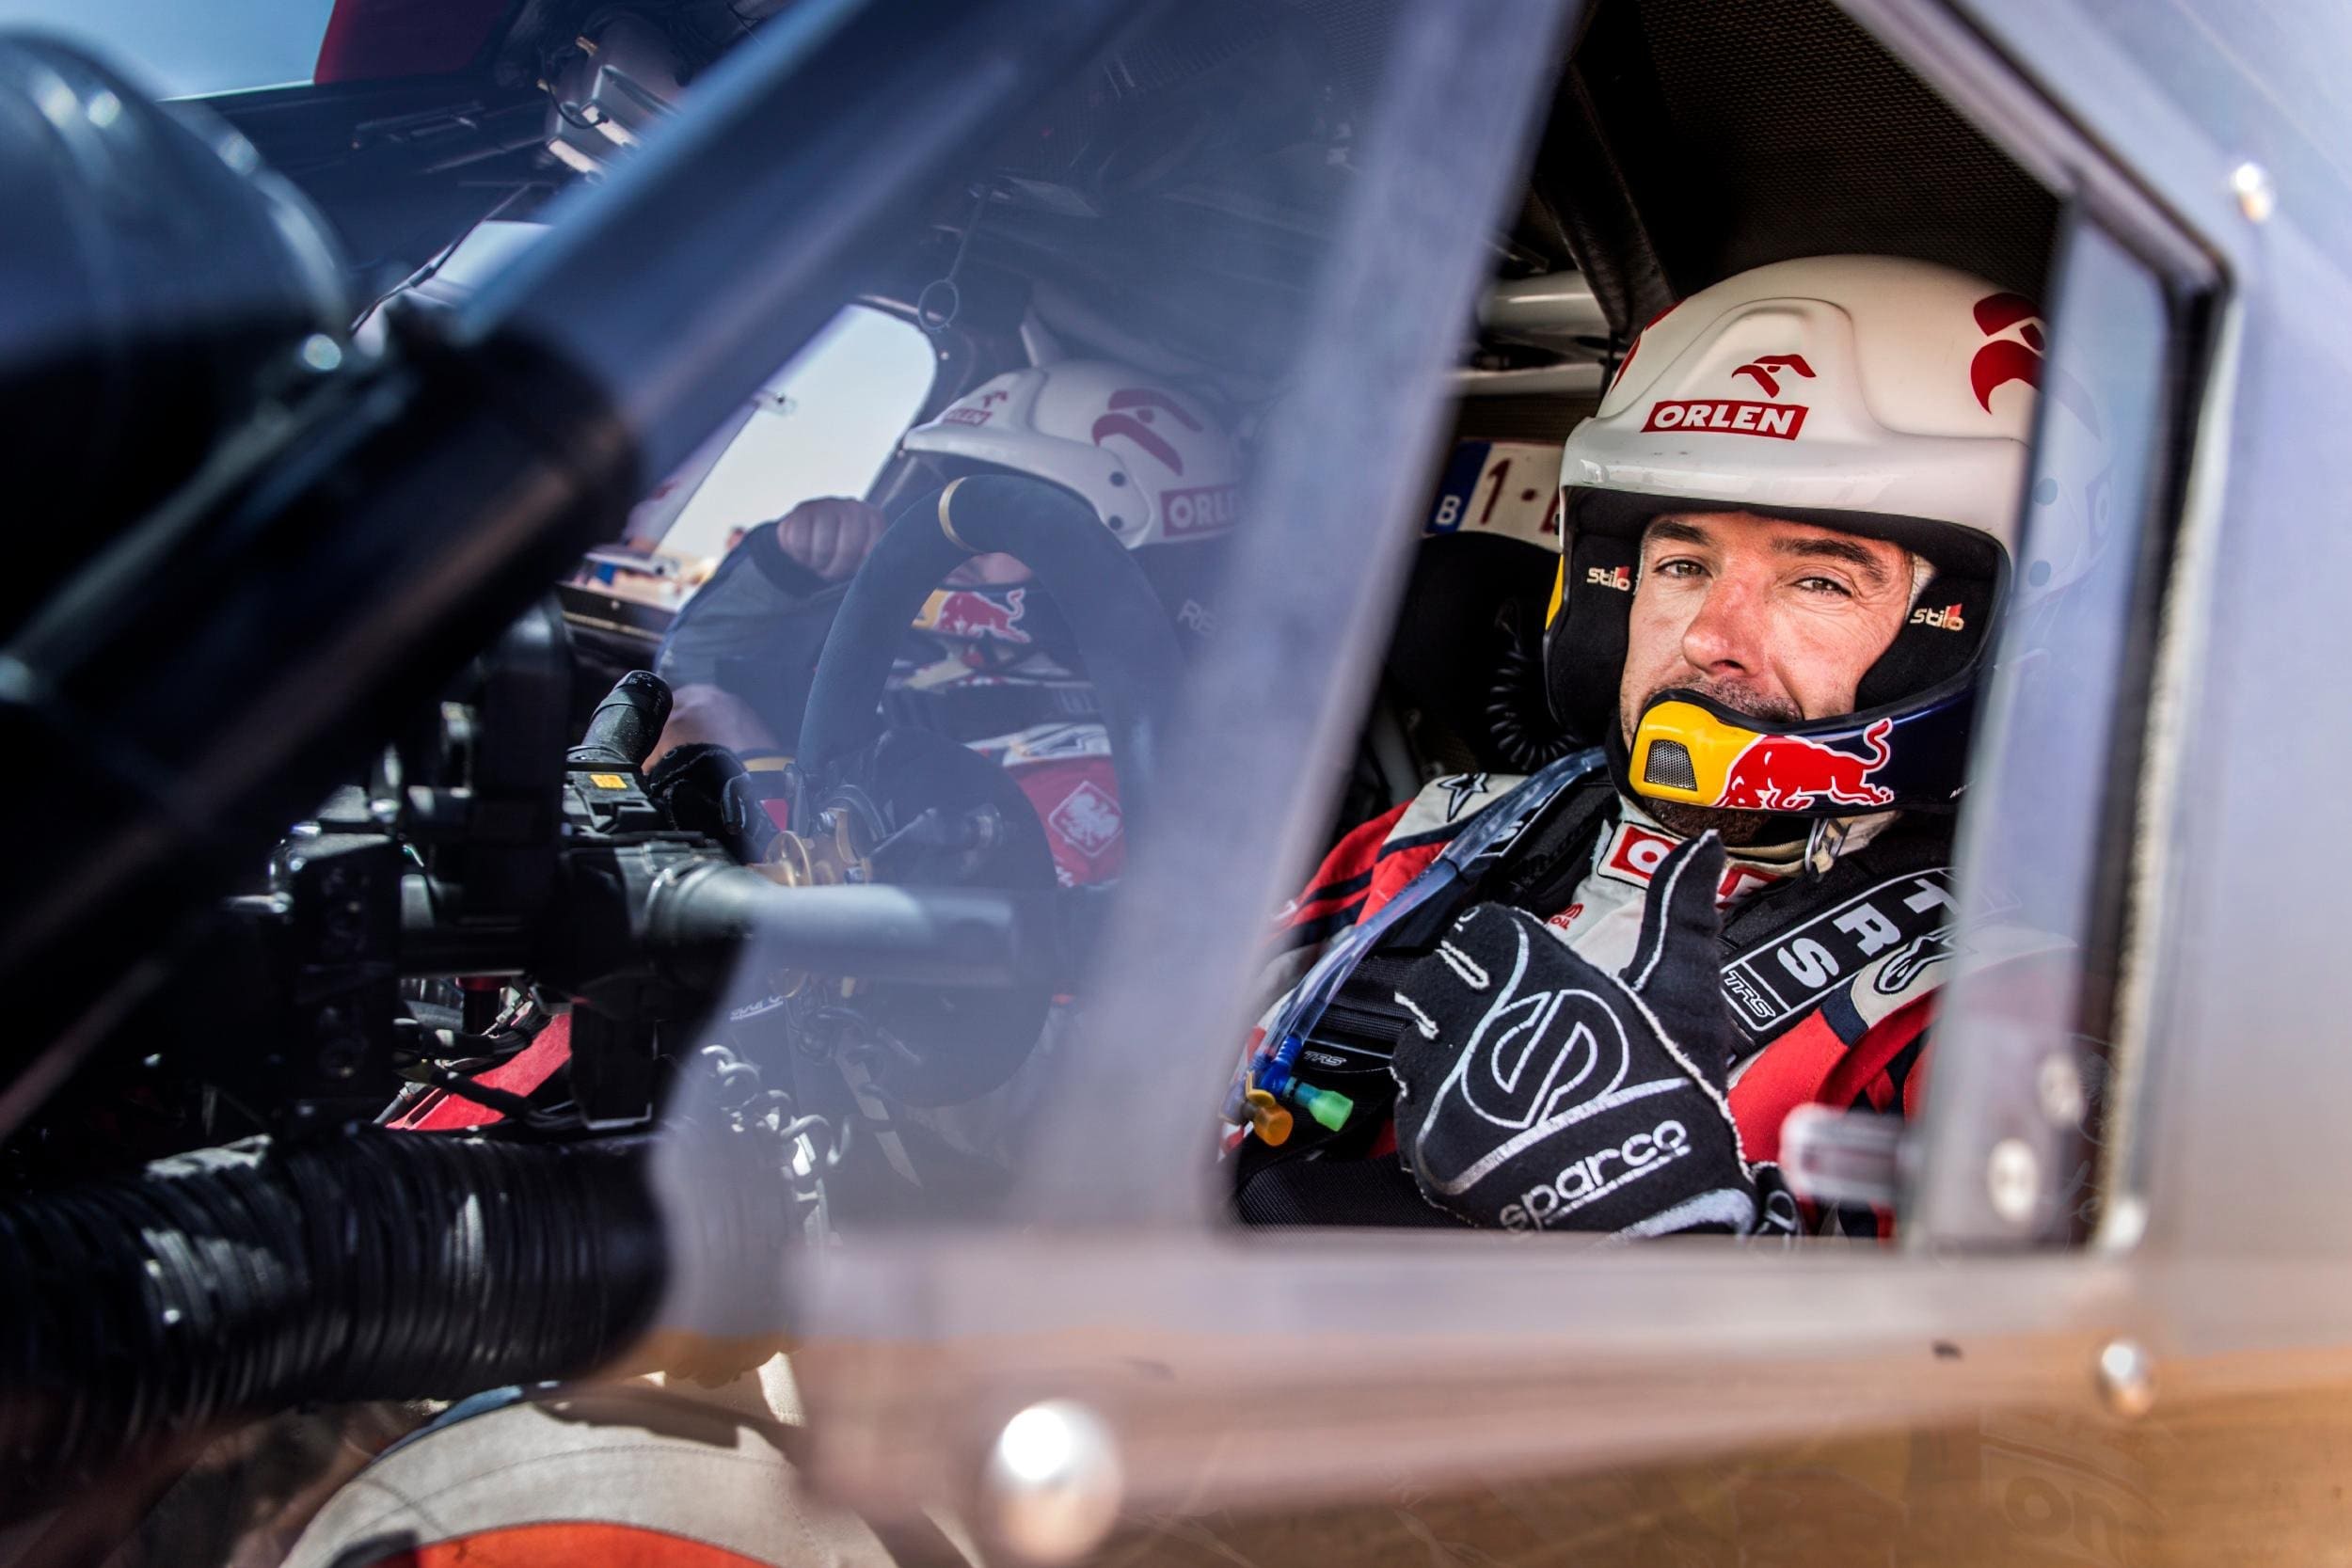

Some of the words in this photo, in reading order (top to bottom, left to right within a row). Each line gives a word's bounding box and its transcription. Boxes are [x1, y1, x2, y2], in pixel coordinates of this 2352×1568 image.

[1654, 404, 1796, 436] ORLEN
[1434, 494, 1461, 527] B
[1909, 603, 1965, 632] stilo
[1724, 969, 1777, 1019] TRS
[1303, 1050, 1347, 1067] TRS
[1499, 1119, 1687, 1234] sparco
